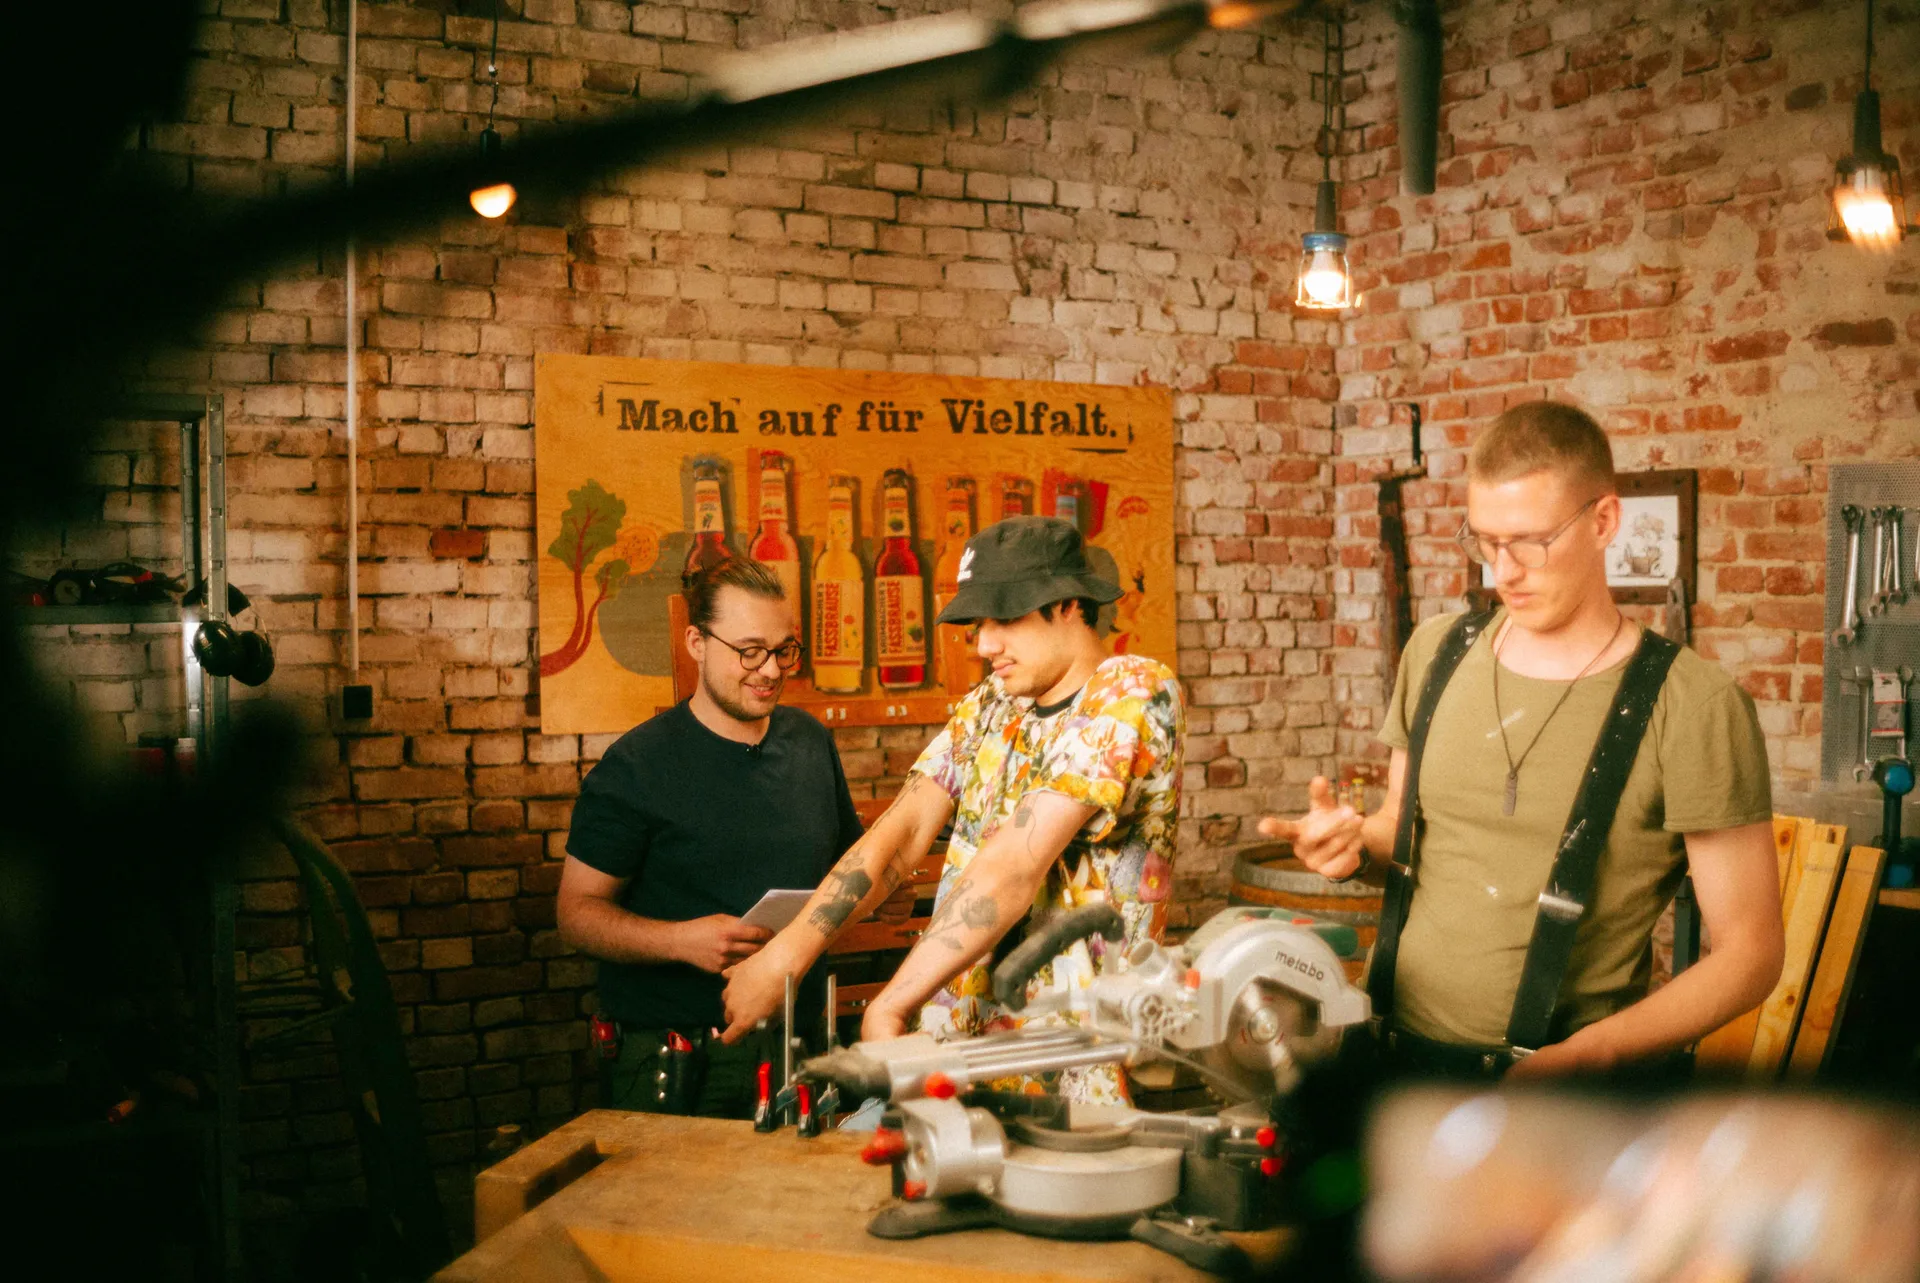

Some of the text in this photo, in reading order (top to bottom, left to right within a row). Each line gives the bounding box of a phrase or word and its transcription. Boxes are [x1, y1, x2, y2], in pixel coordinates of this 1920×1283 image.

[616, 398, 1117, 438] Mach auf für Vielfalt.
[824, 582, 839, 657] FASSBRAUSE
[887, 580, 902, 653] FASSBRAUSE
[1275, 950, 1325, 981] metabo
